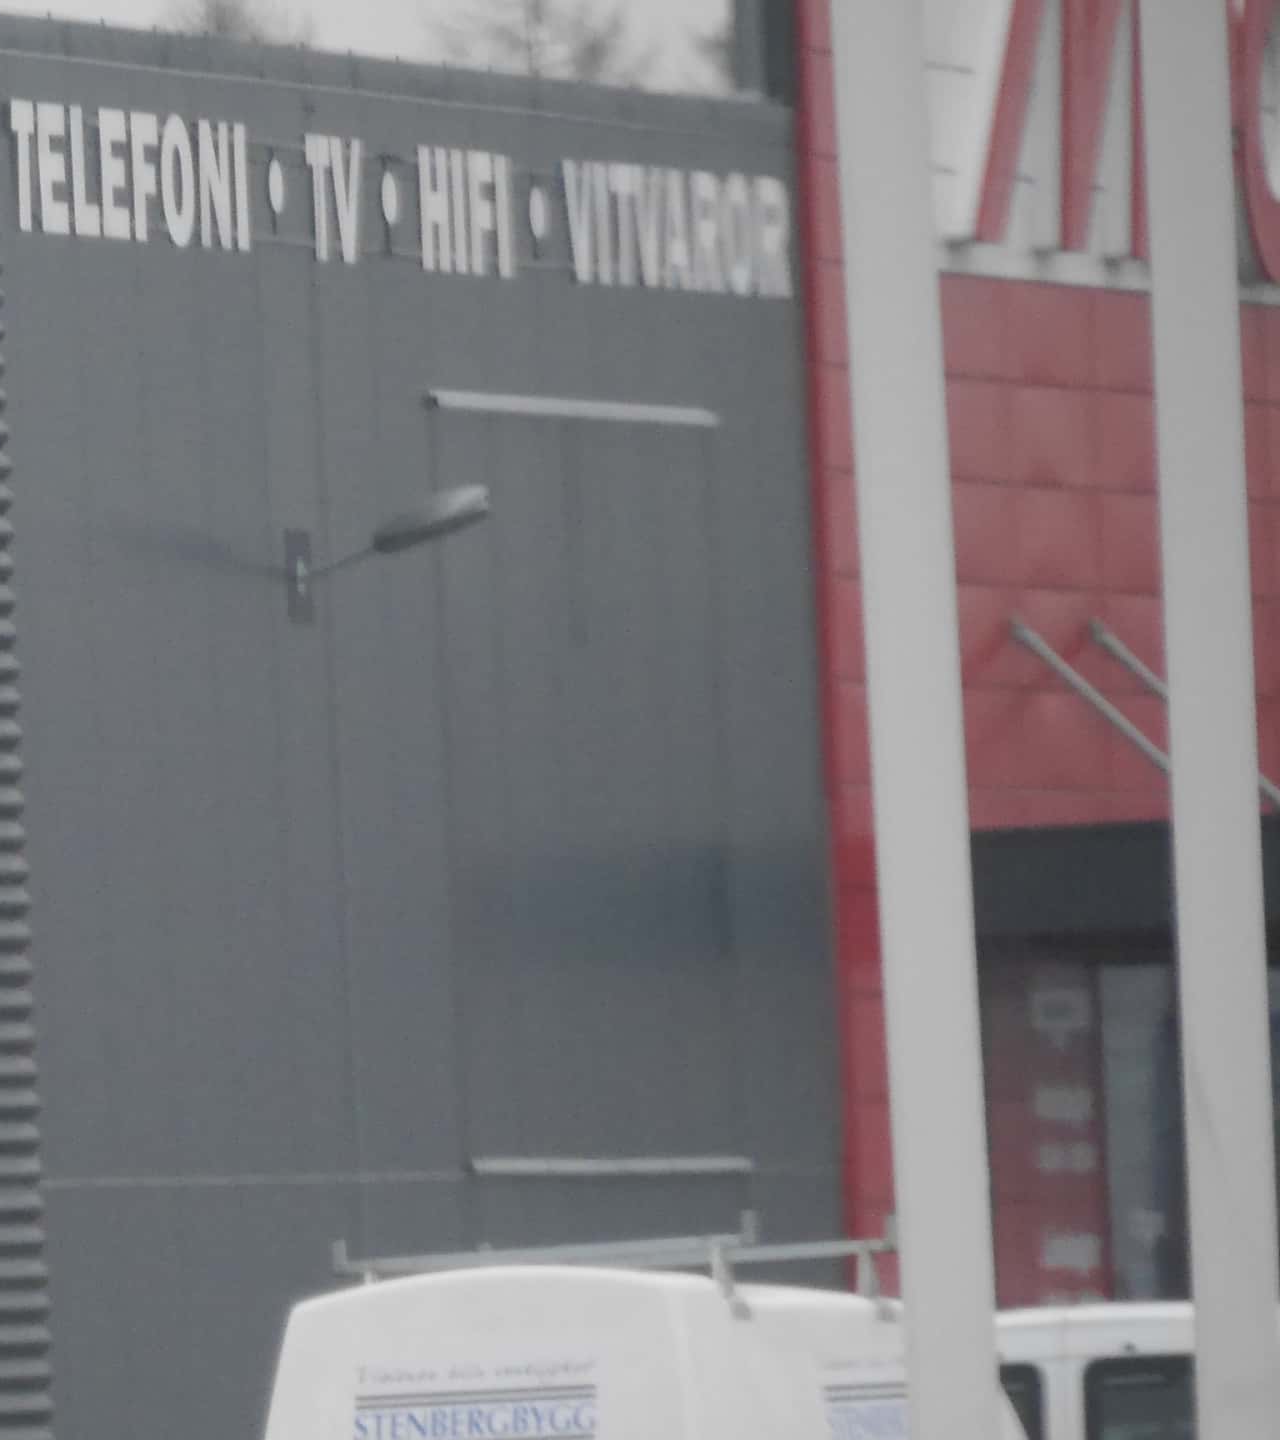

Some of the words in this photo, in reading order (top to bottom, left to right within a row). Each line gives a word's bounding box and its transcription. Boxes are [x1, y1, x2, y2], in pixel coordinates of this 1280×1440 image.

[9, 98, 251, 254] TELEFONI
[304, 133, 362, 264] TV
[417, 144, 514, 280] HIFI
[561, 158, 794, 299] VITVAROR
